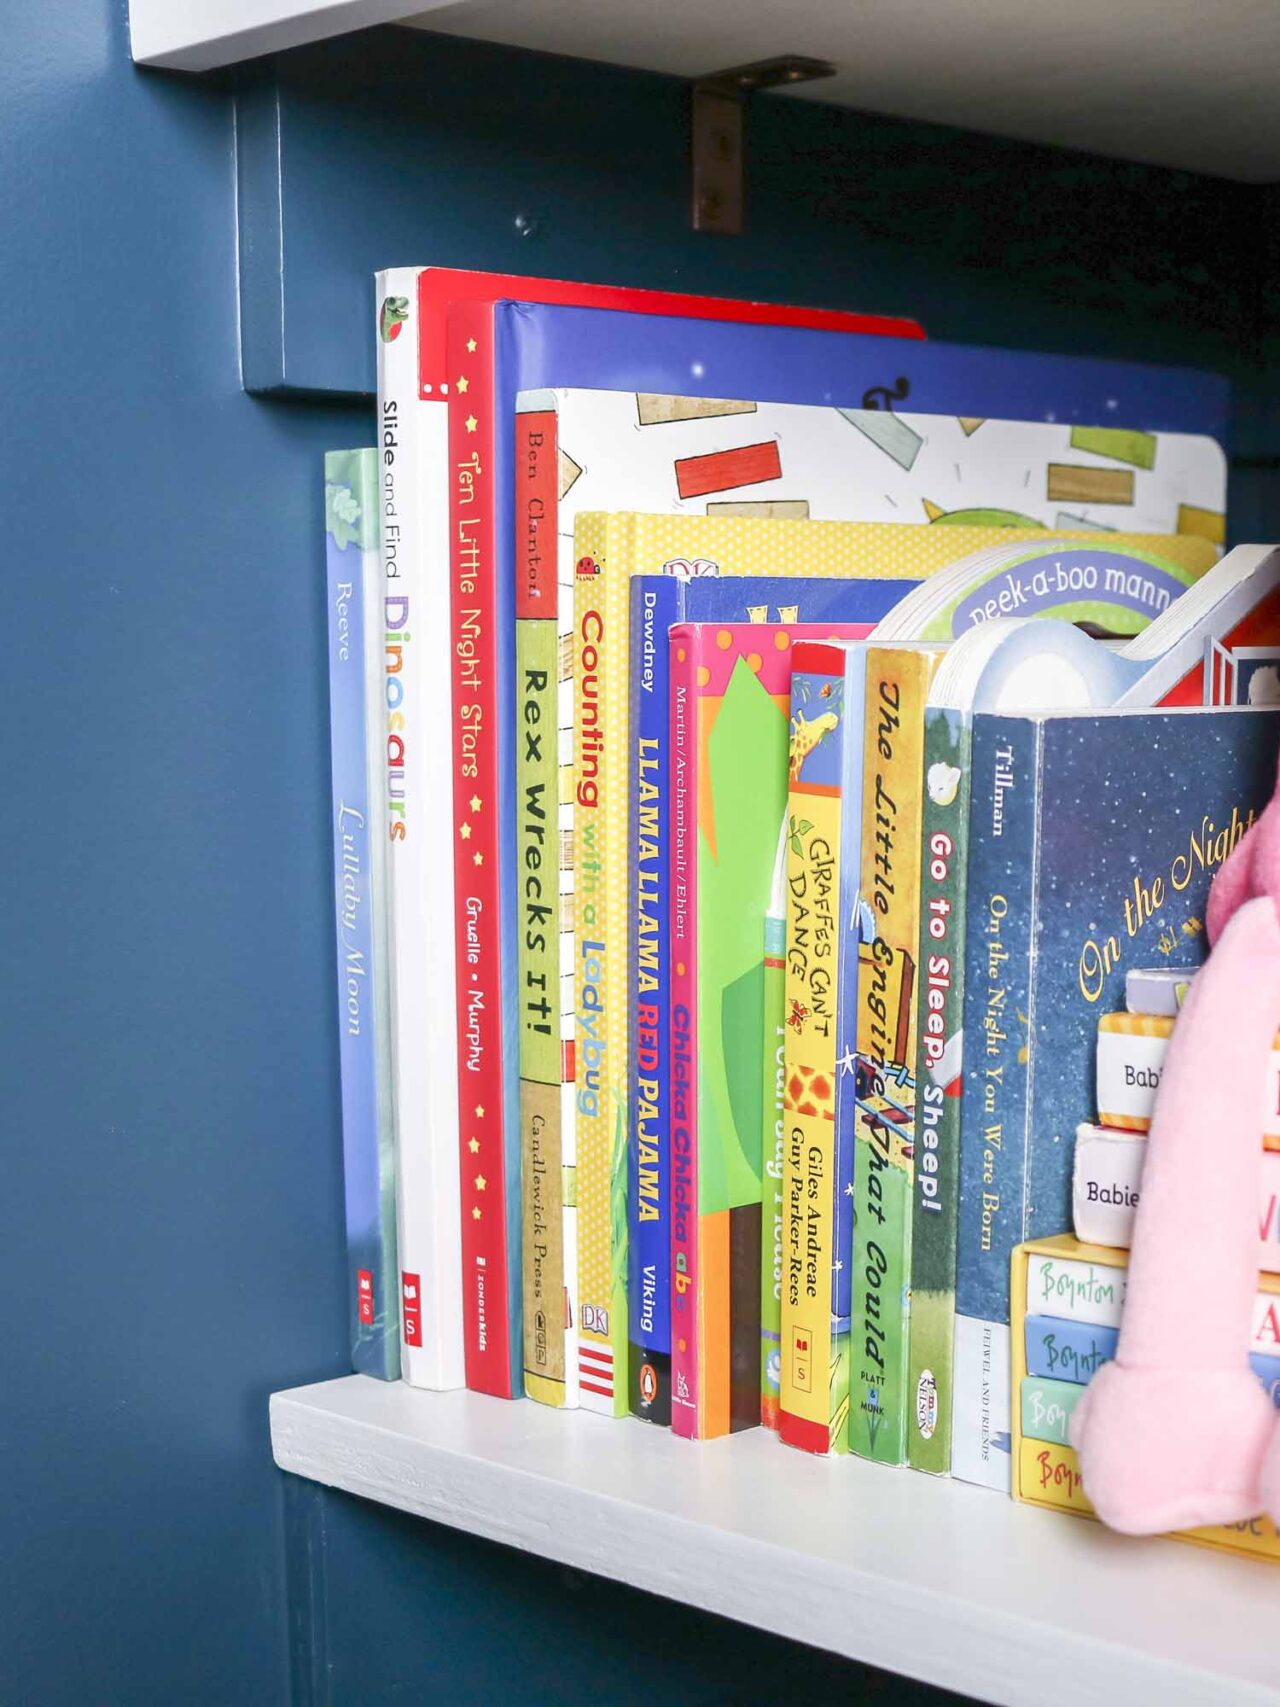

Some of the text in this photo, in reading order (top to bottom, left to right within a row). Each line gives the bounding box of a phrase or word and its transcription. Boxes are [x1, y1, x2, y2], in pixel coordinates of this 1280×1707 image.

[527, 430, 545, 600] Ben Clanton
[336, 581, 353, 662] Reeve
[382, 400, 410, 842] Slide and Find Dinosaurs
[456, 452, 482, 779] Ten Little Night Stars
[641, 591, 660, 695] Dewdney
[1104, 566, 1177, 612] mann
[524, 669, 548, 762] Rex
[992, 746, 1014, 837] Tillman
[336, 800, 367, 1037] Lullaby Moon
[576, 608, 607, 1118] Counting with a Ladybug
[787, 870, 810, 982] DANCE
[465, 896, 484, 1073] Gruelle Murphy
[637, 737, 663, 1223] LLAMA LLAMA RED PAJAMA
[809, 837, 836, 1037] GIRAFFES CAN'T
[1079, 936, 1122, 1002] On
[1124, 875, 1165, 937] the
[672, 1004, 690, 1121] Chicka
[864, 681, 900, 1369] The Little Engine That Could
[919, 832, 952, 1213] Go to Sleep, Sheep!
[980, 894, 1009, 1252] On the Night You Were Born
[531, 1112, 548, 1300] Candlewick Press
[673, 1127, 690, 1242] Chicka
[788, 1126, 807, 1307] Guy Parker-Rees
[805, 1145, 825, 1298] Giles Andreae
[640, 1264, 657, 1333] Viking
[1040, 1261, 1114, 1309] Boynton
[861, 1370, 886, 1387] PLATT
[861, 1401, 885, 1417] MUNK
[980, 1408, 991, 1462] FRIENDS
[981, 1378, 991, 1406] AND
